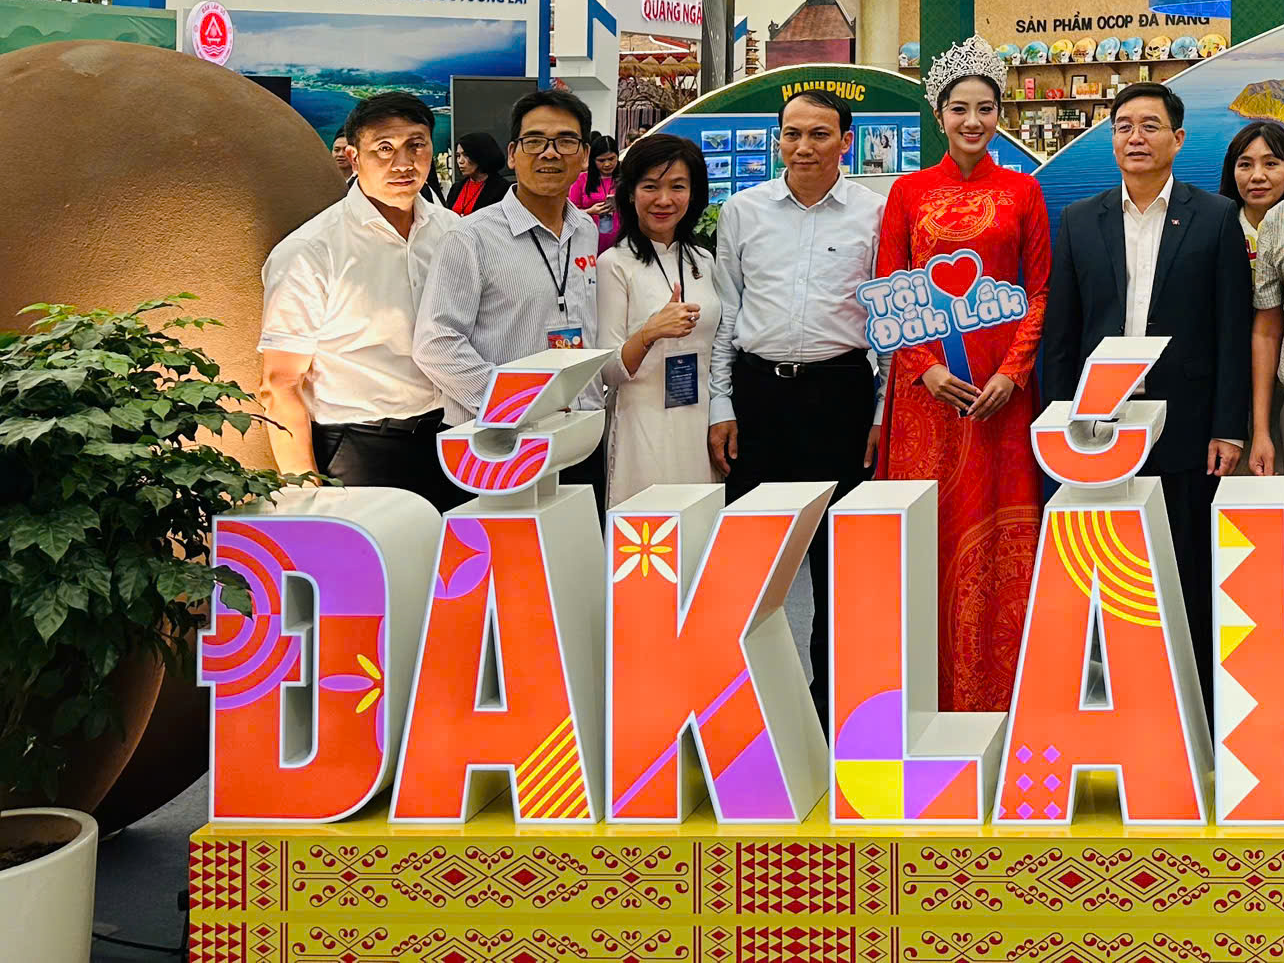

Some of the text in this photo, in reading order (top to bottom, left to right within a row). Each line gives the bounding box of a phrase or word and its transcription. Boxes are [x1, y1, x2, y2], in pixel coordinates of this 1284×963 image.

[682, 1, 703, 26] NGÃ
[1015, 15, 1047, 33] SẢN
[1053, 10, 1093, 32] PHẨM
[1096, 14, 1134, 30] OCOP
[826, 80, 866, 101] PHÚC
[862, 275, 930, 317] Tôi
[871, 283, 1025, 349] Đắk Lắk
[198, 362, 800, 825] ĐẮK
